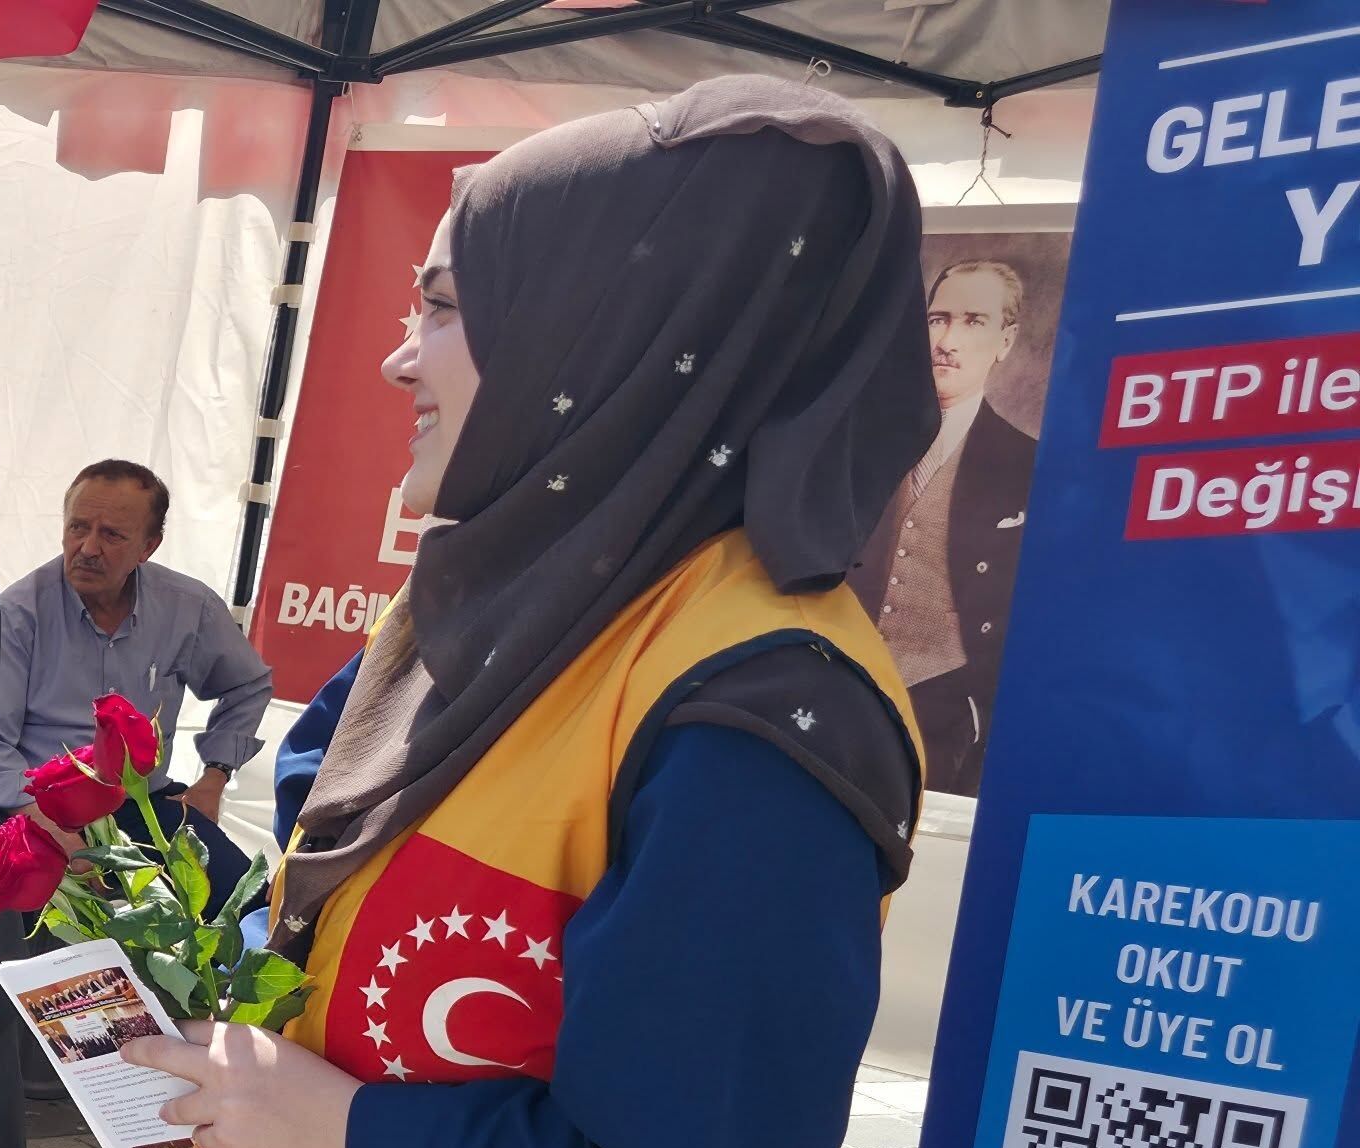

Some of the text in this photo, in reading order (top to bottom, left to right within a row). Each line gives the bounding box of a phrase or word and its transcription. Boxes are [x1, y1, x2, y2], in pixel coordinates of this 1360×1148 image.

[1118, 358, 1360, 430] BTP ile
[1146, 456, 1360, 529] Değiş
[1066, 873, 1319, 943] KAREKODU
[1116, 944, 1243, 998] OKUT
[1056, 996, 1284, 1072] VE ÜYE OL
